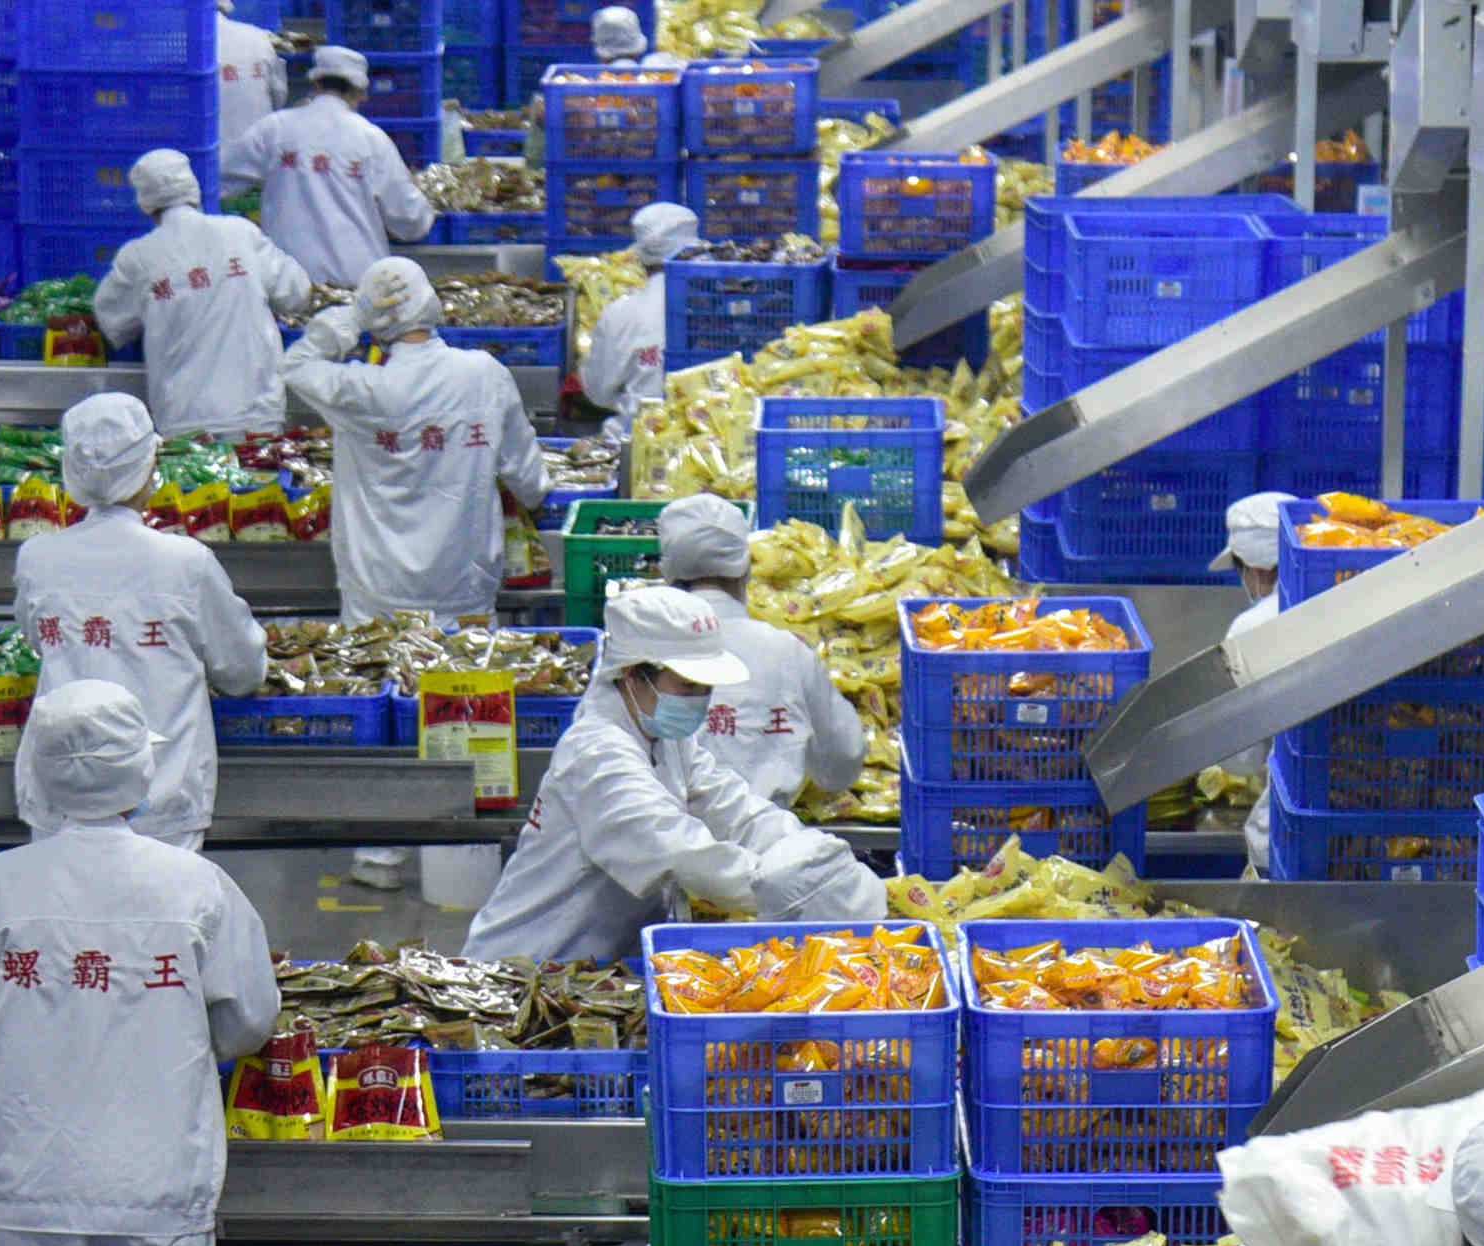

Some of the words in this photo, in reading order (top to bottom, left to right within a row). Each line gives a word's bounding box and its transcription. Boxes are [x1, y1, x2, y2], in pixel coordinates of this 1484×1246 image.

[151, 256, 247, 301] 螺霸王
[375, 422, 491, 454] 螺霸王
[36, 615, 169, 649] 螺霸王
[1, 946, 186, 993] 螺霸王
